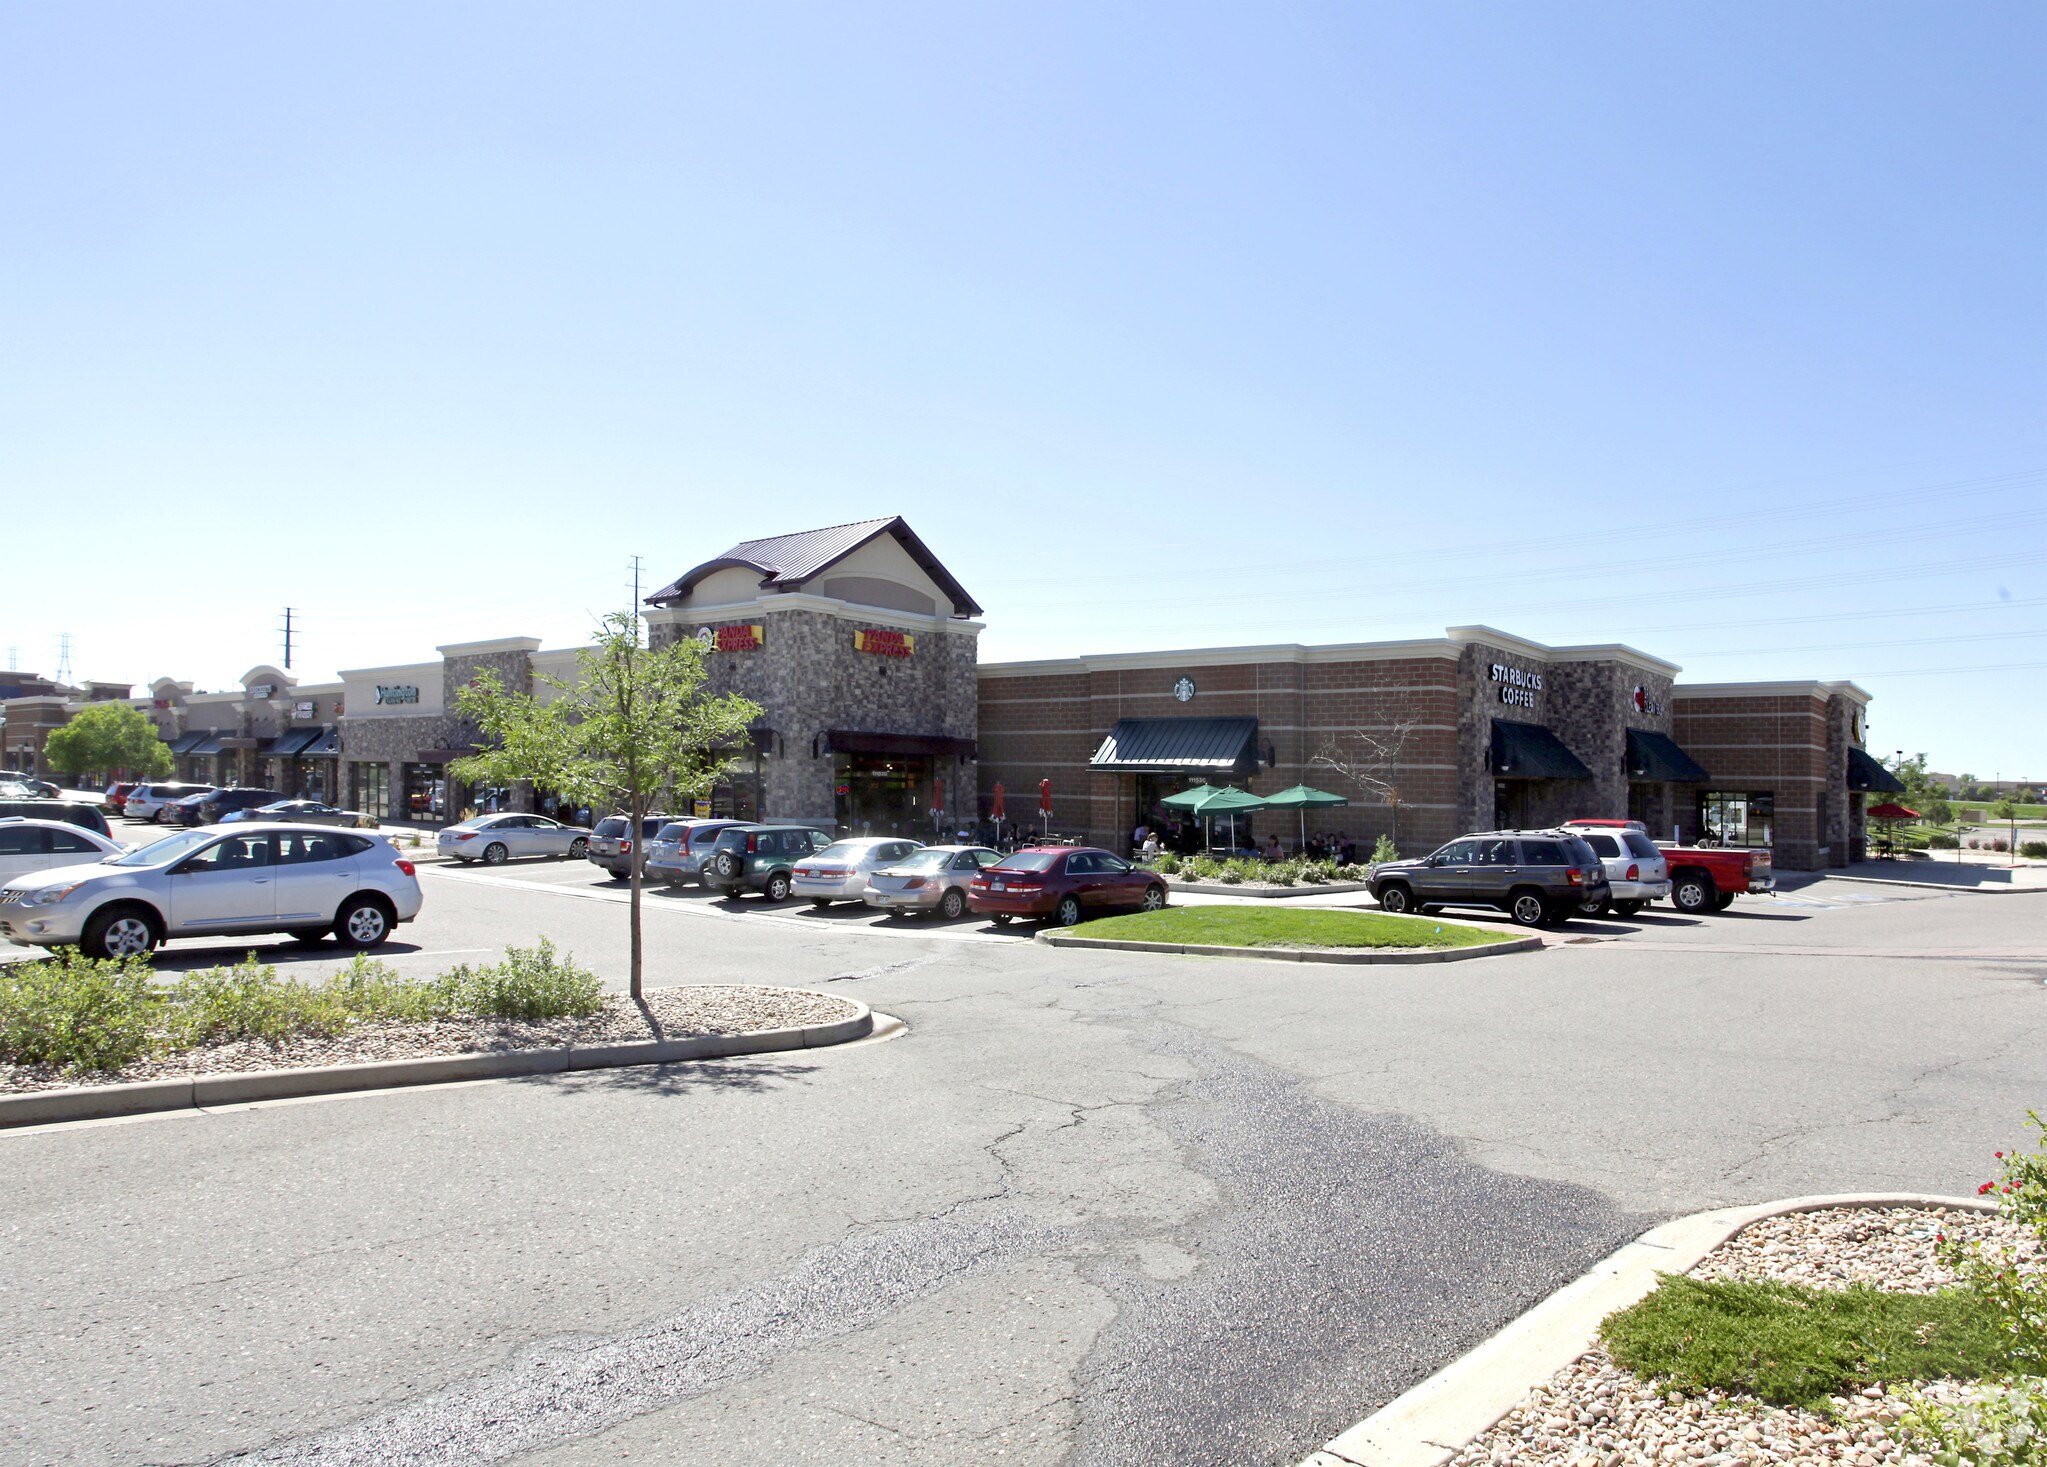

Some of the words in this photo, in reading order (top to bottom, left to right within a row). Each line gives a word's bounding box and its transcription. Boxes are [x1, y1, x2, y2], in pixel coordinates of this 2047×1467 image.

[717, 626, 750, 638] PANDA
[864, 629, 904, 644] PANDA
[717, 637, 755, 651] EXPRESS
[862, 640, 910, 656] EXPRESS
[1491, 664, 1542, 690] STARBUCKS
[1502, 686, 1534, 708] COFFEE
